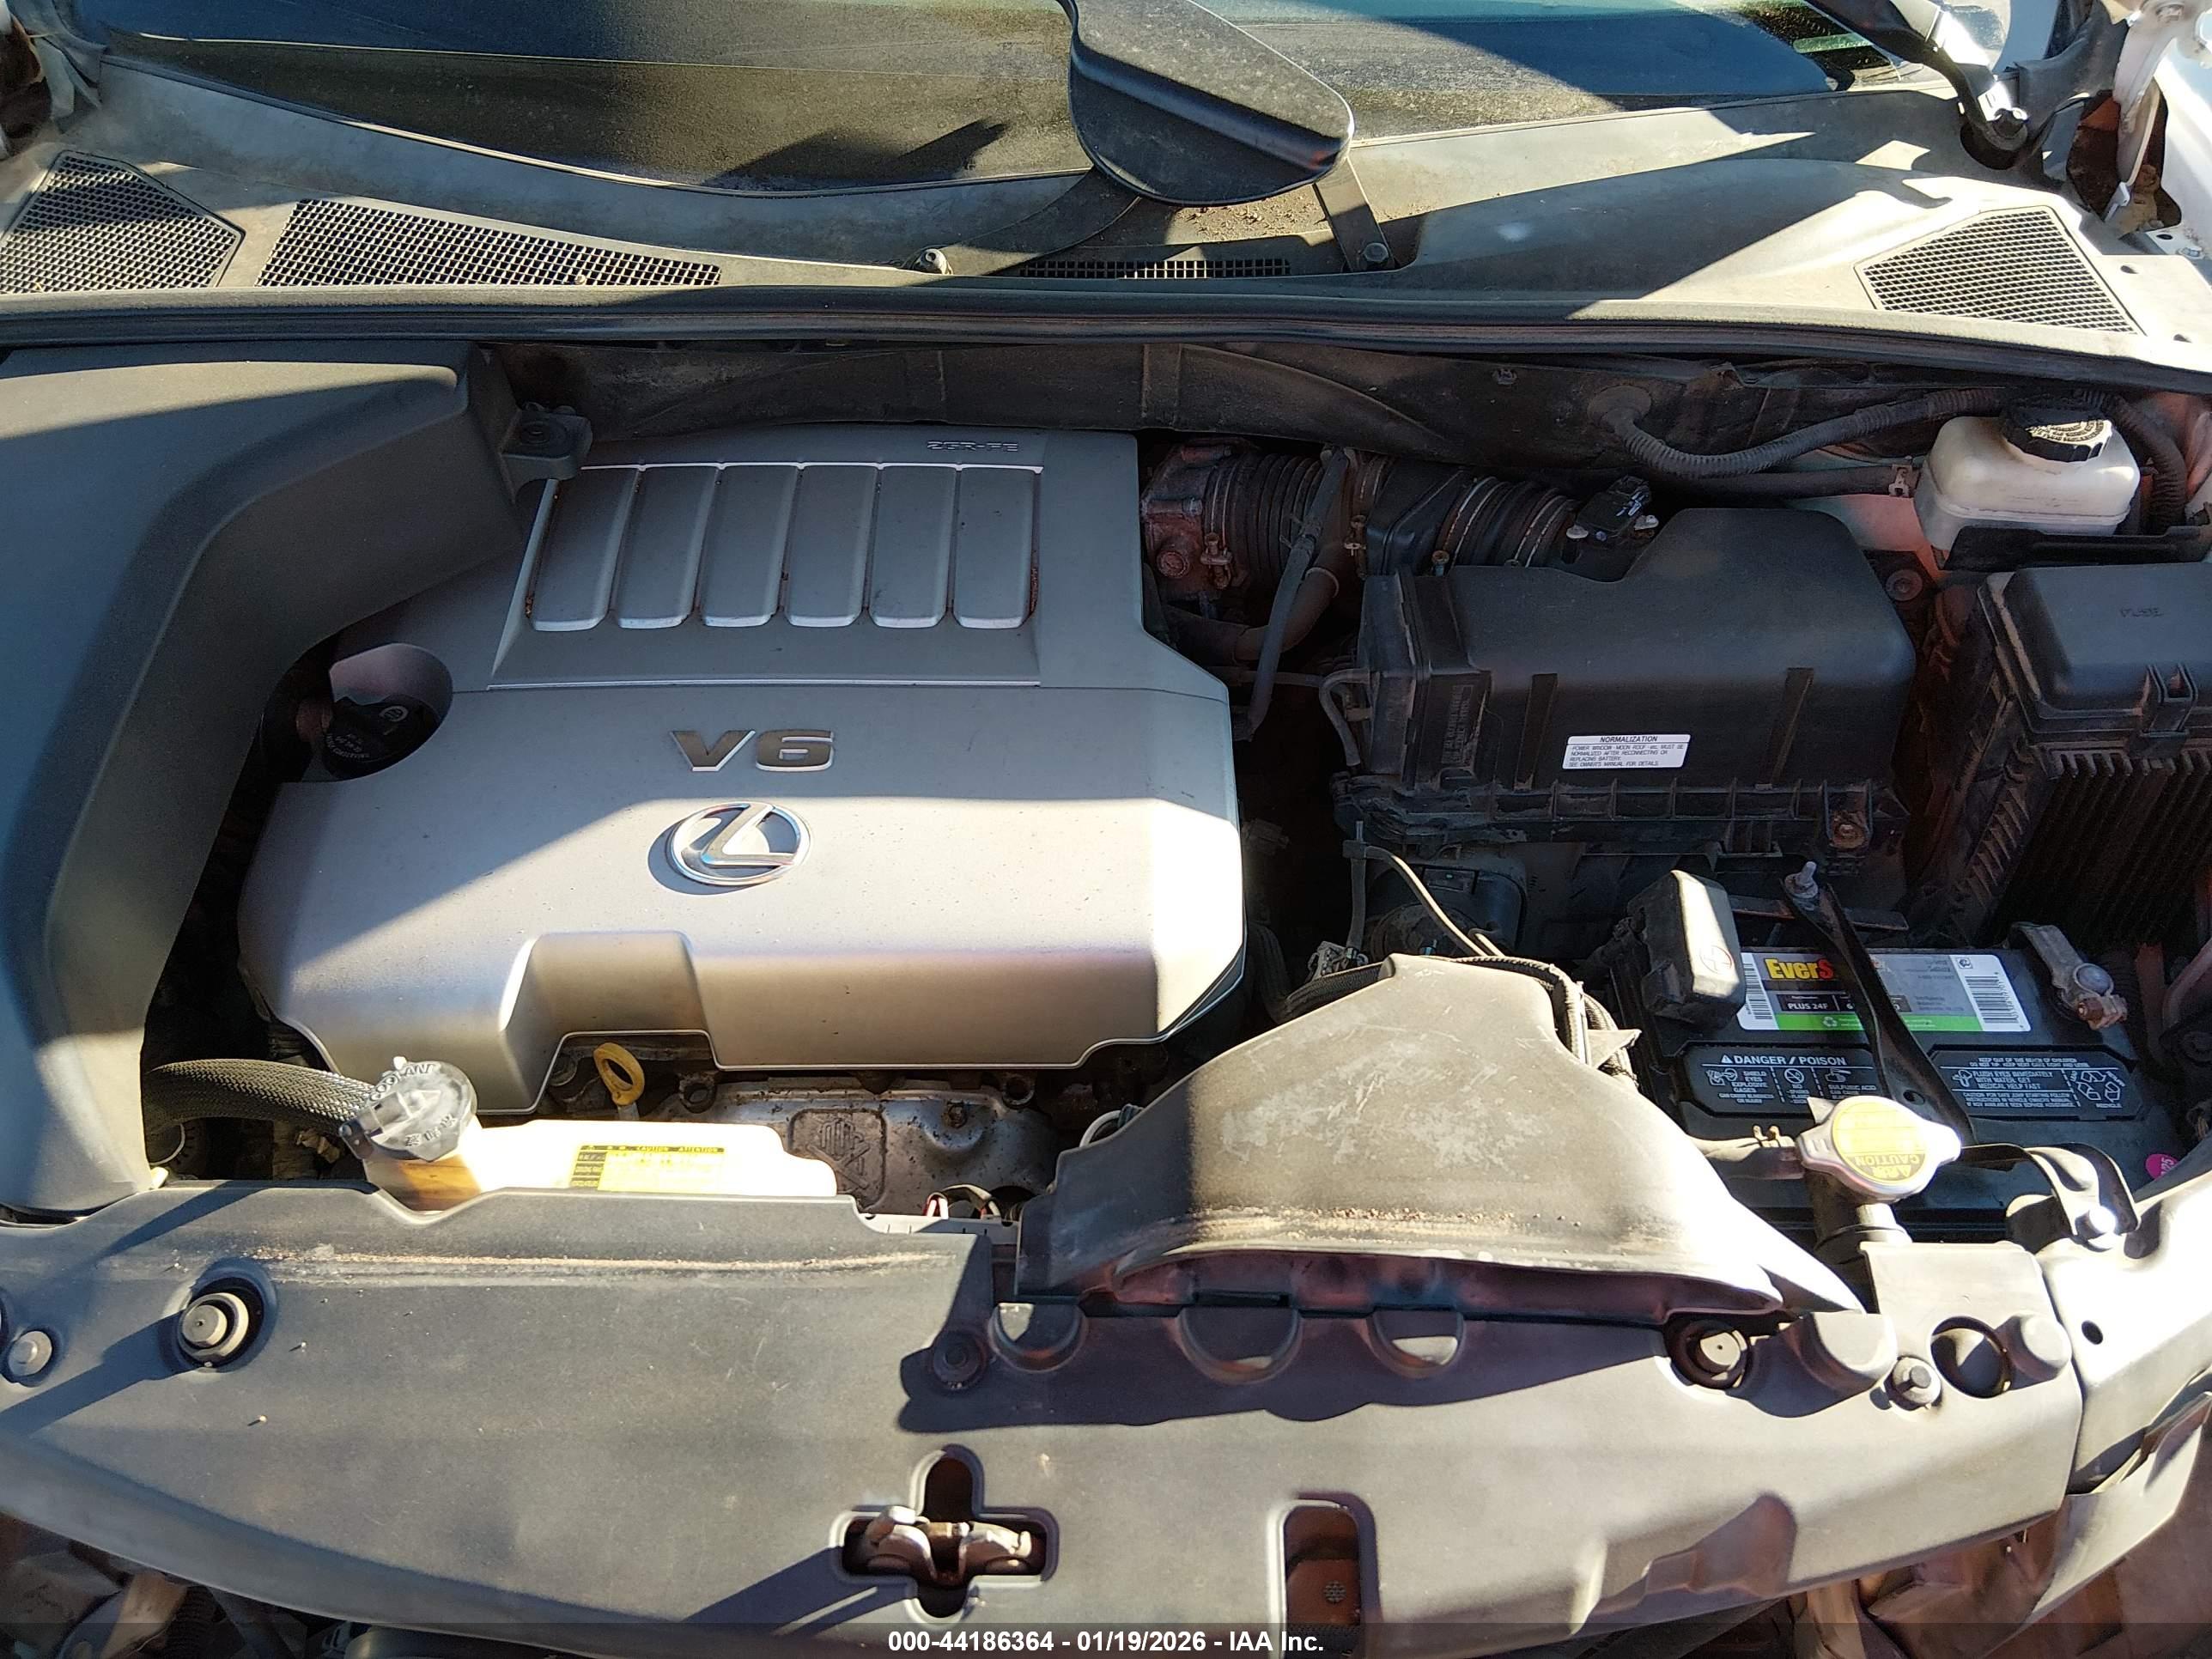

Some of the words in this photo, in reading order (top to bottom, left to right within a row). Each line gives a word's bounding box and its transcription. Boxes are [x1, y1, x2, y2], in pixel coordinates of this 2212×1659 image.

[670, 729, 835, 772] V6
[1734, 1055, 1786, 1066] DANGER
[1788, 1056, 1796, 1065] /
[1798, 1056, 1847, 1066] POISON
[369, 1063, 439, 1101] COOLANT
[1855, 1153, 1920, 1165] CAUTION
